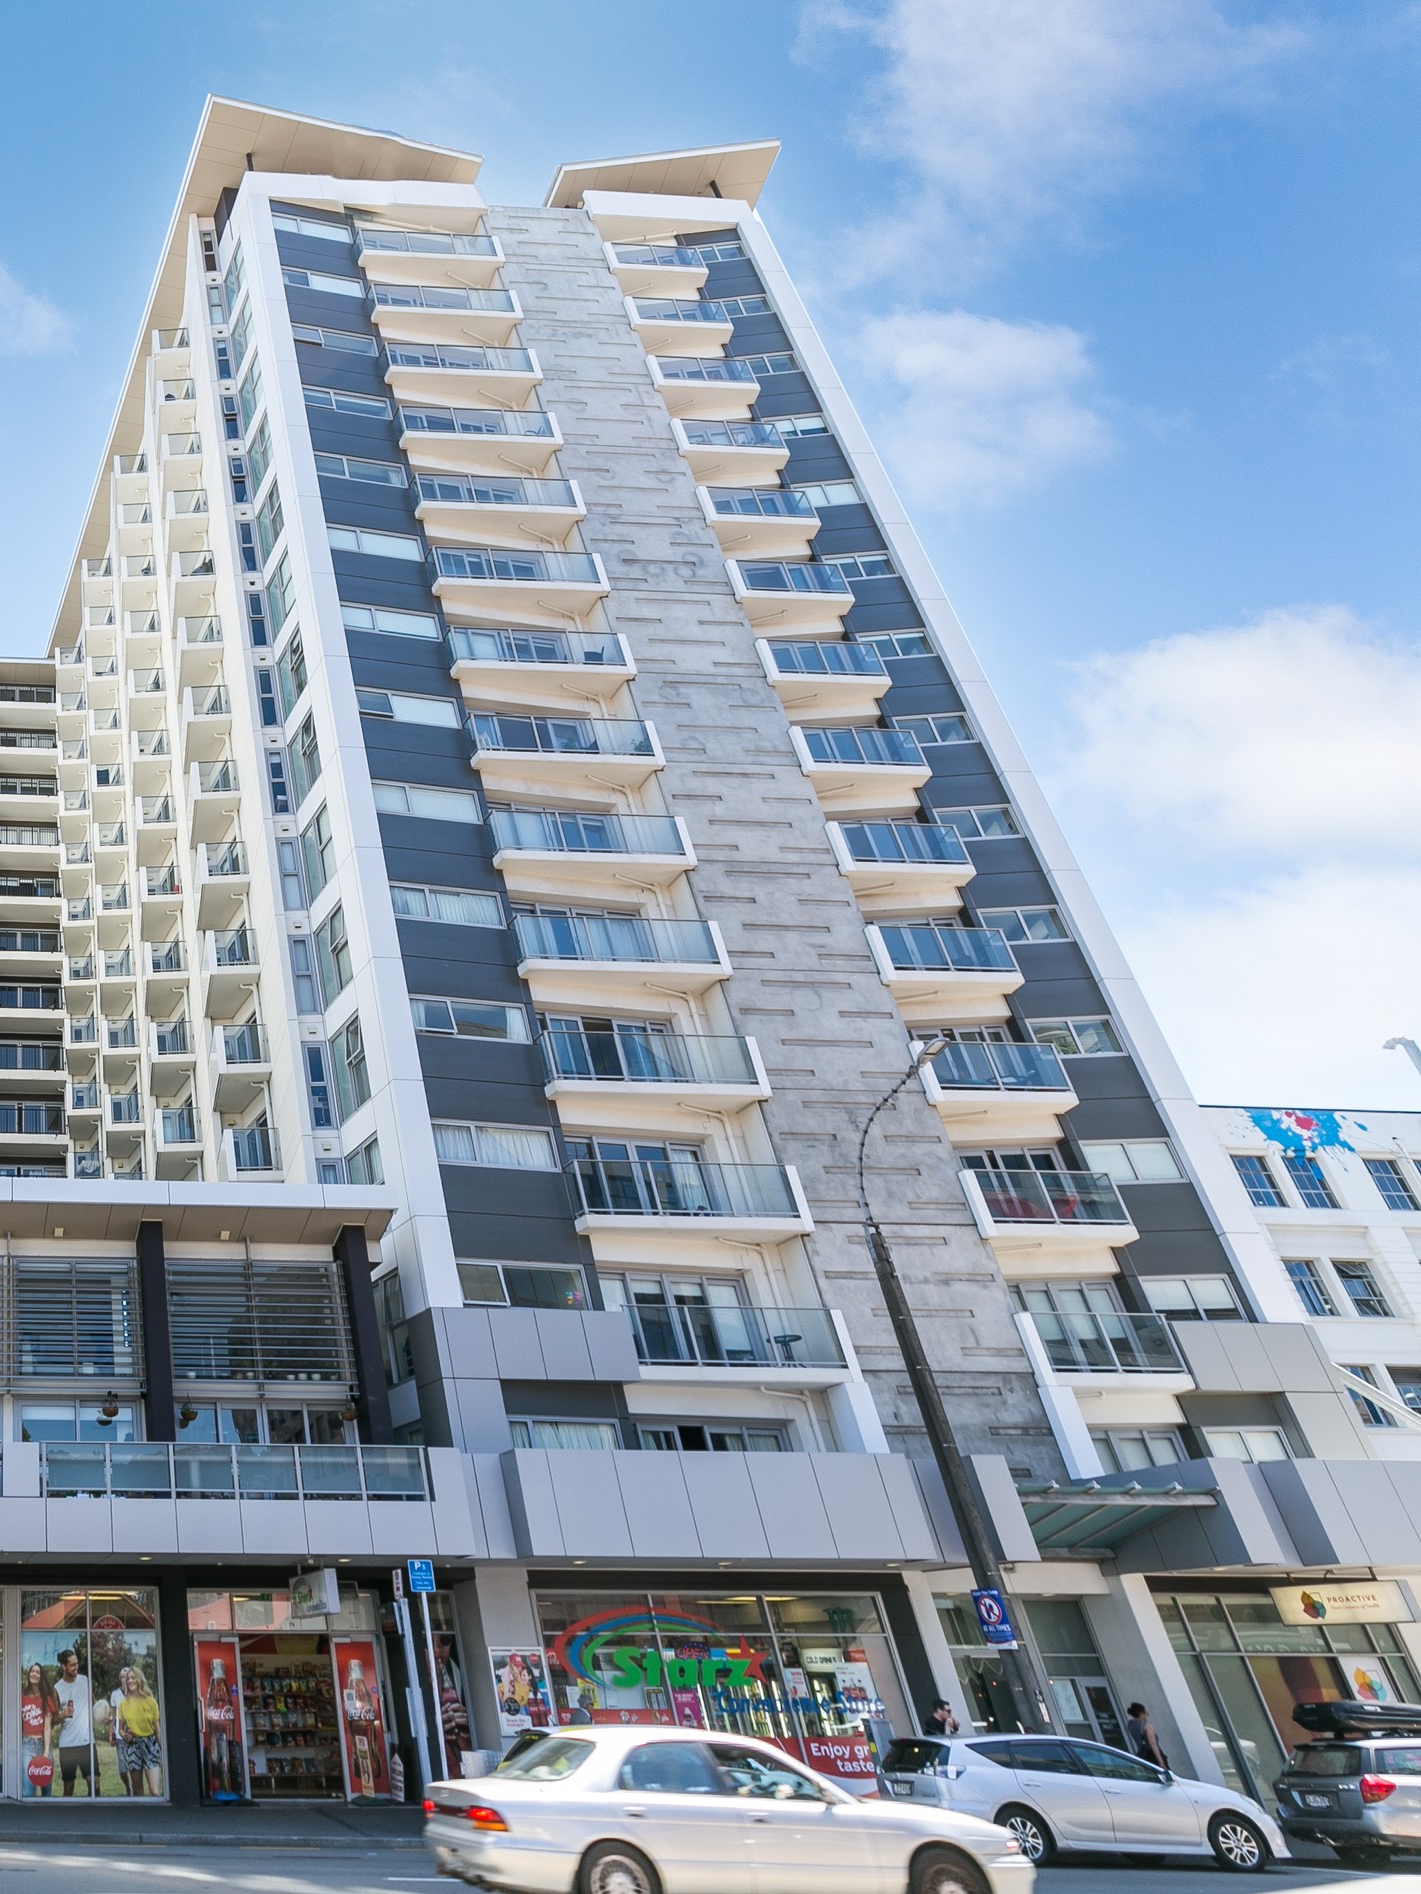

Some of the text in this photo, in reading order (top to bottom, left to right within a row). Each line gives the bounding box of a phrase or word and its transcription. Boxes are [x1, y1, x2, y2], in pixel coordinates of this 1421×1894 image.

[415, 1561, 421, 1570] P
[1327, 1595, 1377, 1603] PROACTIVE
[612, 1646, 754, 1688] Starz
[713, 1690, 886, 1715] Convenience Store
[811, 1743, 850, 1759] Enjoy
